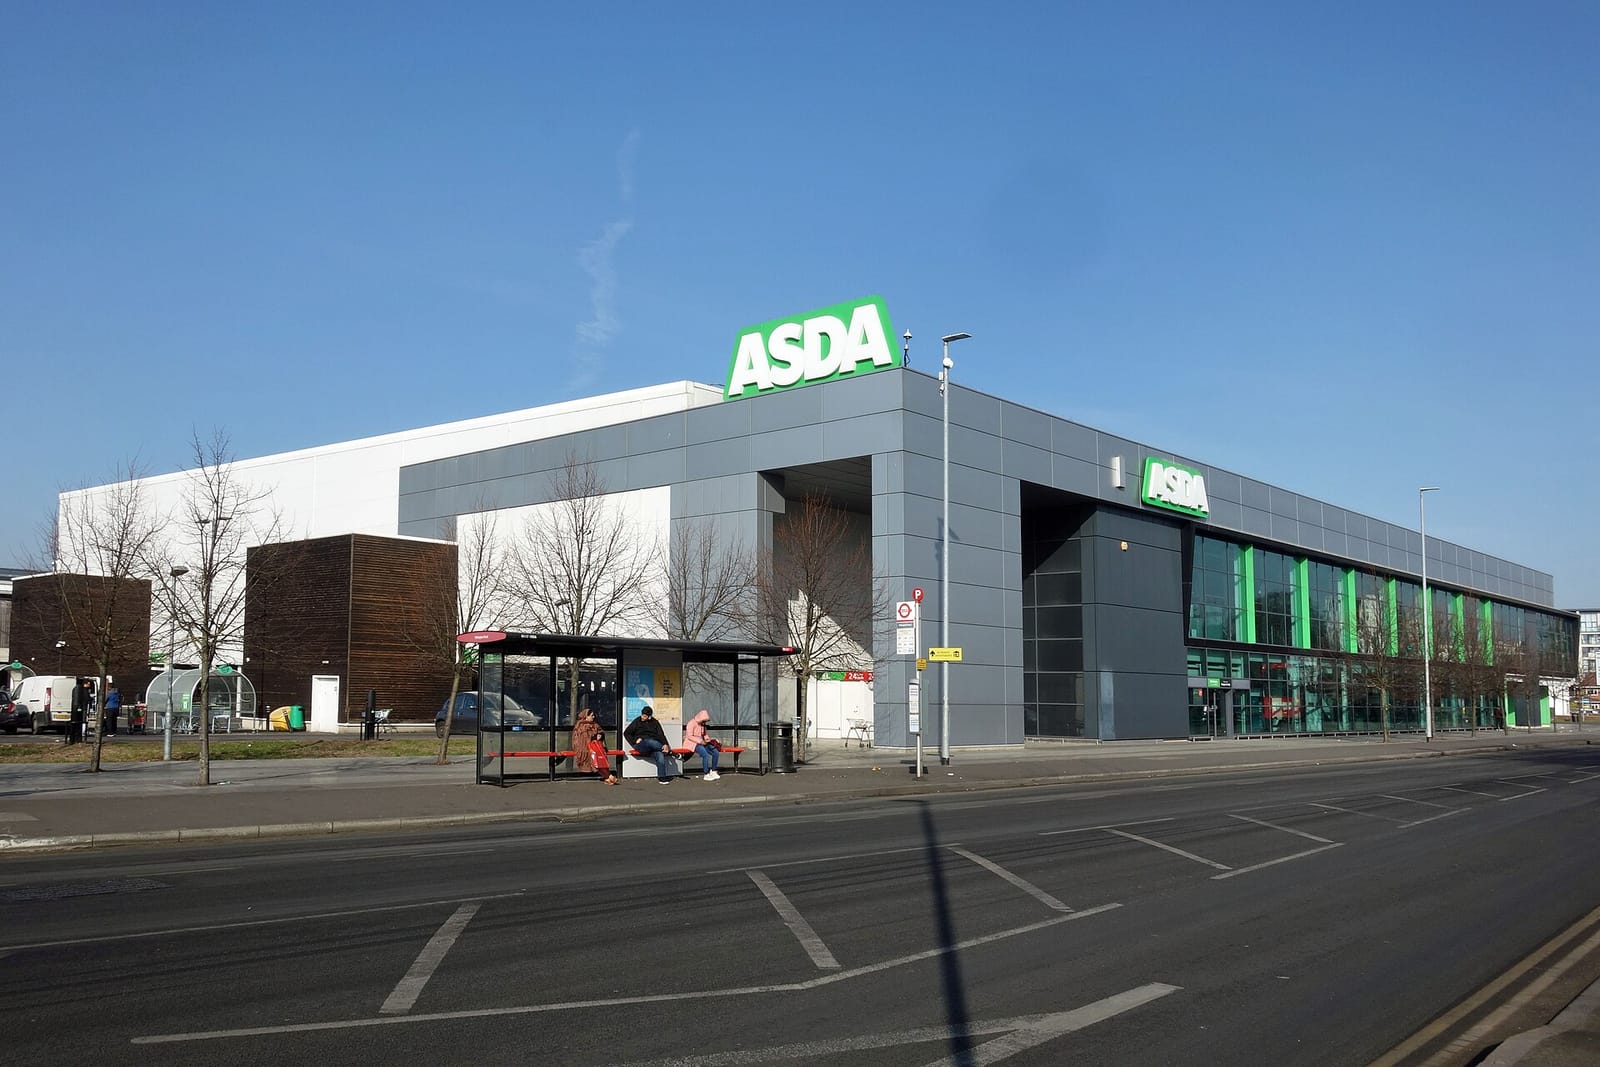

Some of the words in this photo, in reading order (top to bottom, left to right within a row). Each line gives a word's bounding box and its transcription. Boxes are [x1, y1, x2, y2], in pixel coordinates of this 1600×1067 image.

[728, 303, 893, 396] ASDA
[1148, 462, 1209, 513] ASDA
[915, 589, 922, 599] P
